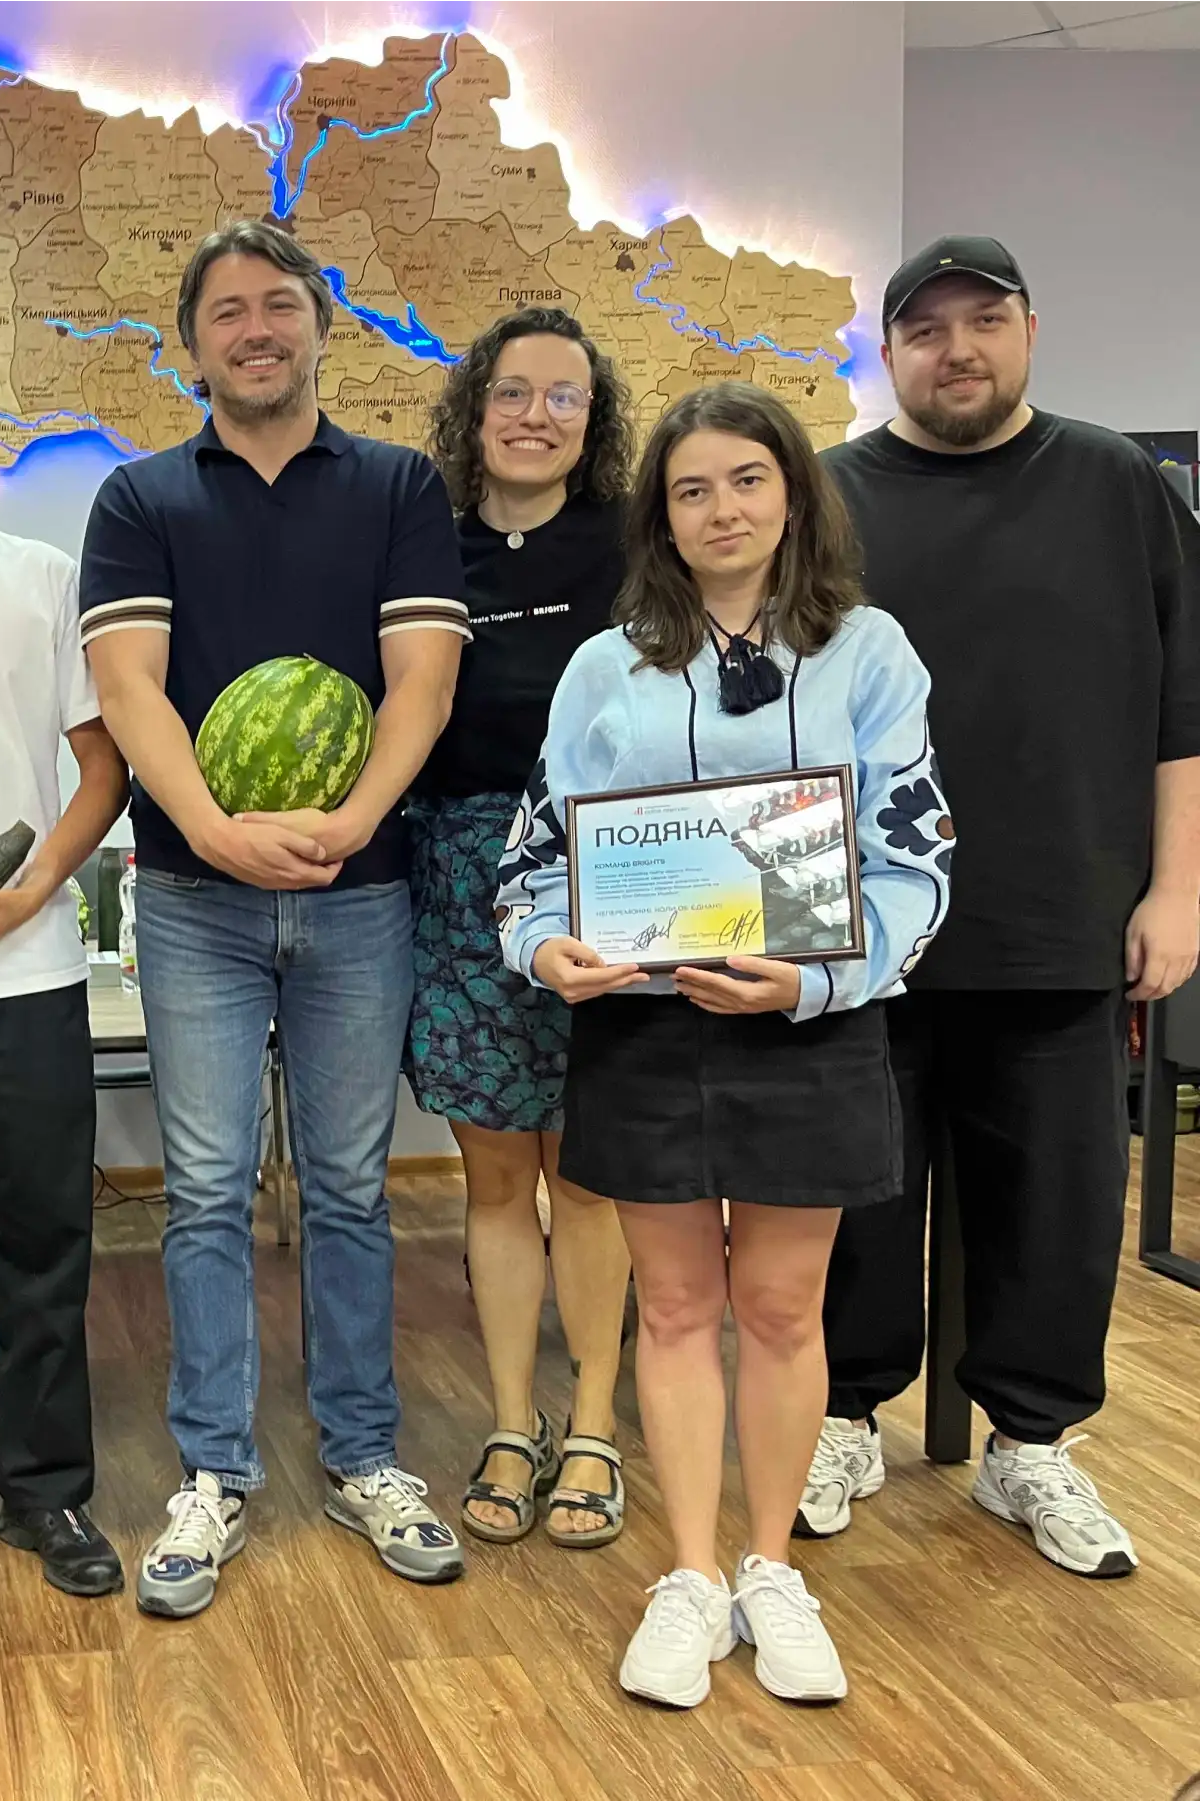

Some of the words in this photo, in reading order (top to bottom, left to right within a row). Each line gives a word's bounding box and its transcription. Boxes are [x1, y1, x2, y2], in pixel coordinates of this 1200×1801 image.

[307, 95, 356, 109] Чернігів
[490, 165, 523, 178] Суми
[22, 190, 65, 205] Рівне
[128, 227, 192, 242] Житомир
[609, 239, 649, 251] Харків
[499, 287, 562, 301] Полтава
[19, 307, 108, 320] Хмельницький
[113, 336, 150, 347] Вінниця
[329, 331, 360, 342] каси
[768, 374, 820, 385] Луганськ
[337, 395, 428, 410] Кропивницький
[467, 615, 490, 624] reate
[490, 610, 523, 622] Together
[533, 603, 570, 616] BRIGHTS
[595, 817, 729, 848] ПОДЯКА
